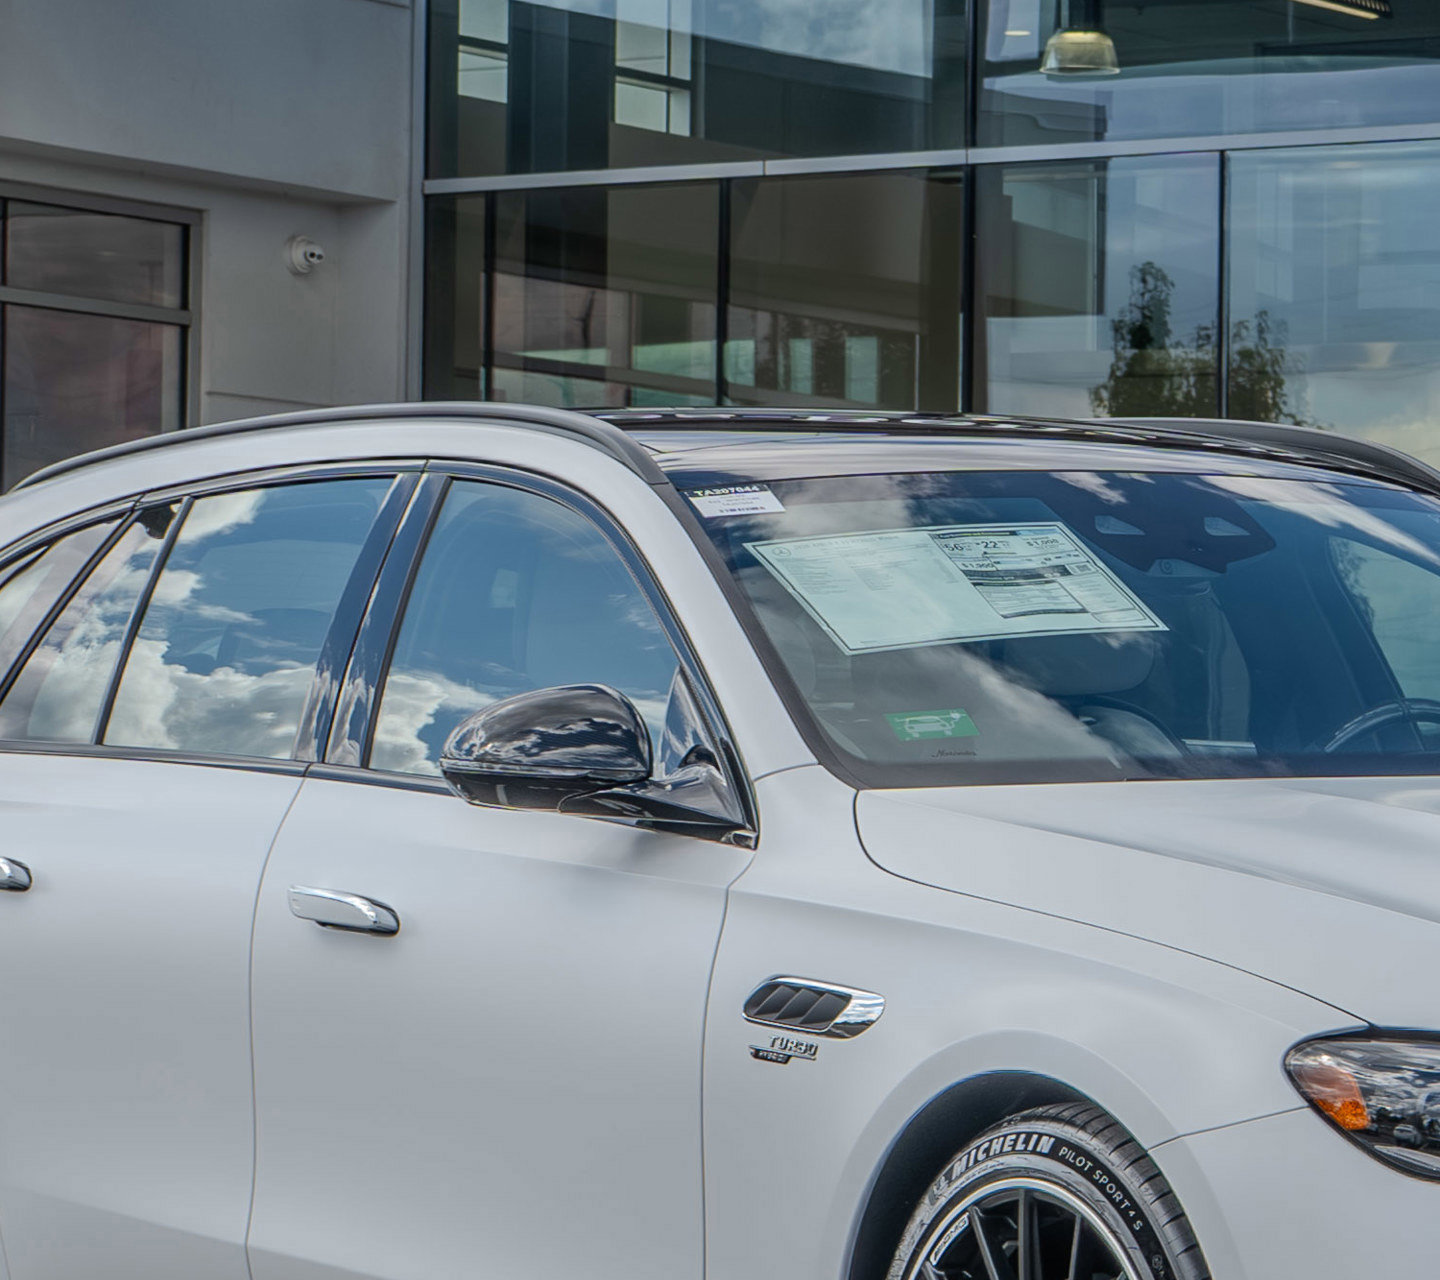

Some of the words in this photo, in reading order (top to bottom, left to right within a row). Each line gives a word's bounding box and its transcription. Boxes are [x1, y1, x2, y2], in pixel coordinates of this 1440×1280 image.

[769, 1035, 818, 1056] TURBO
[951, 1132, 1056, 1181] MICHELIN
[1058, 1146, 1094, 1172] PILOT
[1092, 1169, 1131, 1209] SPORT
[1128, 1209, 1136, 1218] 4
[1132, 1220, 1144, 1231] S
